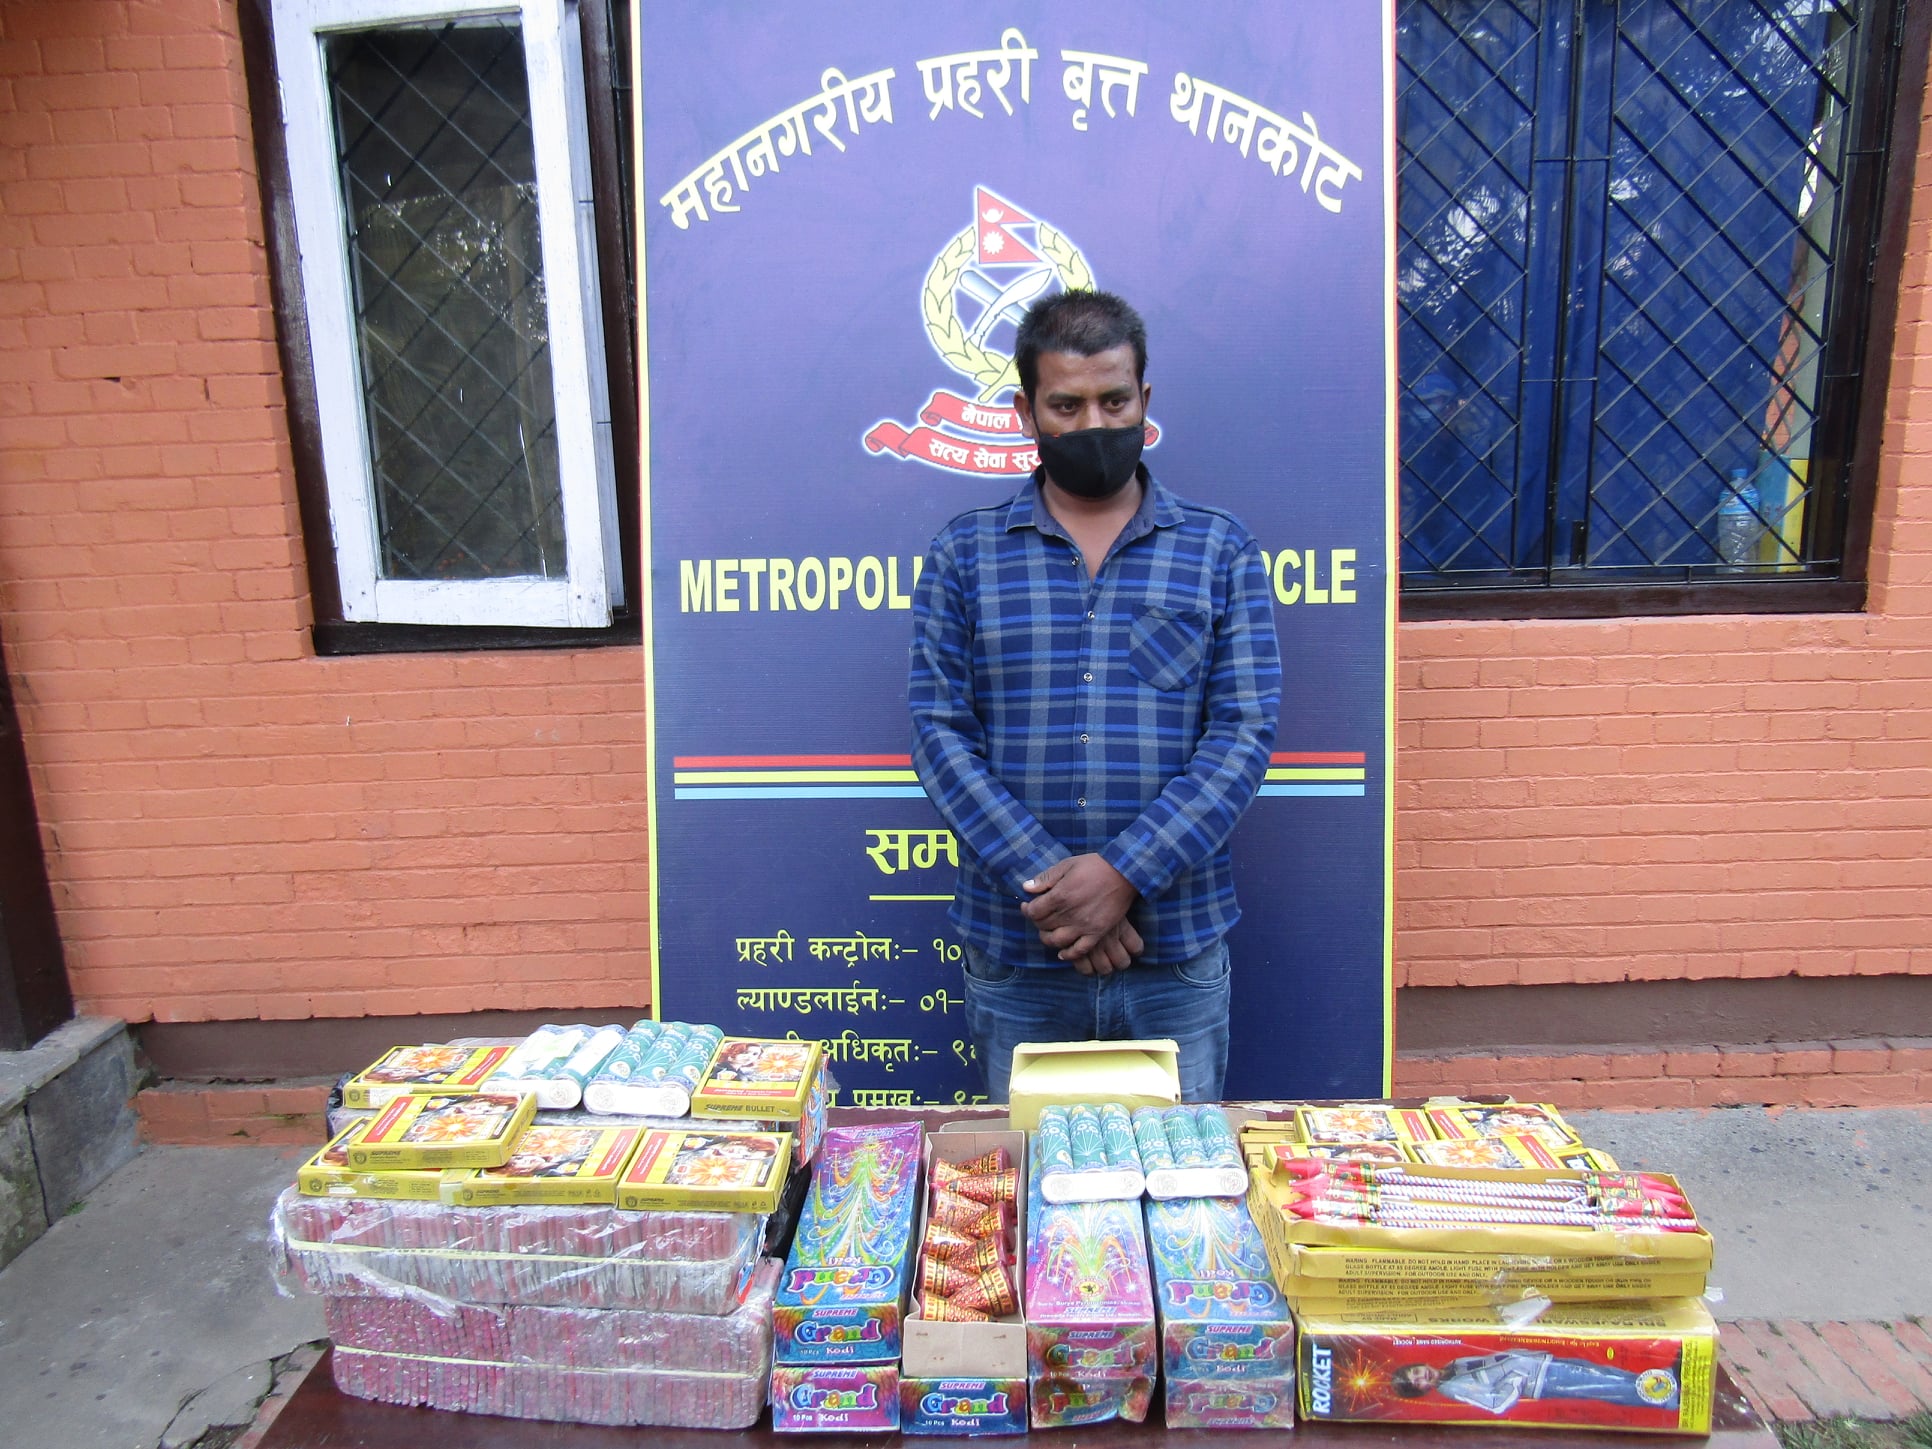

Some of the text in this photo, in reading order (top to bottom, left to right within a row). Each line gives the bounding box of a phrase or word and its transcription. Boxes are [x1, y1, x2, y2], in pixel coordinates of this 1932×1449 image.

[660, 67, 895, 230] महानगरीय
[917, 27, 1038, 120] प्रहरी
[1170, 71, 1363, 214] थानकोट
[961, 405, 1011, 429] नेपाल
[927, 437, 970, 464] सत्य
[973, 447, 1007, 469] सेवा
[1260, 548, 1357, 605] CLE
[735, 929, 795, 966] प्रहरी
[787, 1267, 893, 1292] Grand
[1167, 1281, 1276, 1306] Grand
[812, 1308, 858, 1317] SUPREME
[796, 1320, 880, 1342] Grand
[1068, 1331, 1115, 1339] SUPREME
[1206, 1325, 1254, 1334] SUPREME
[826, 1346, 854, 1354] Kodi
[1187, 1338, 1275, 1361] Grand
[813, 1370, 858, 1379] SUPREME
[1312, 1344, 1332, 1413] ROCKET
[791, 1384, 878, 1410] Grand
[938, 1382, 985, 1390] SUPREME
[921, 1393, 1008, 1415] Grand
[819, 1413, 849, 1422] Kodi
[951, 1418, 980, 1427] Kodi
